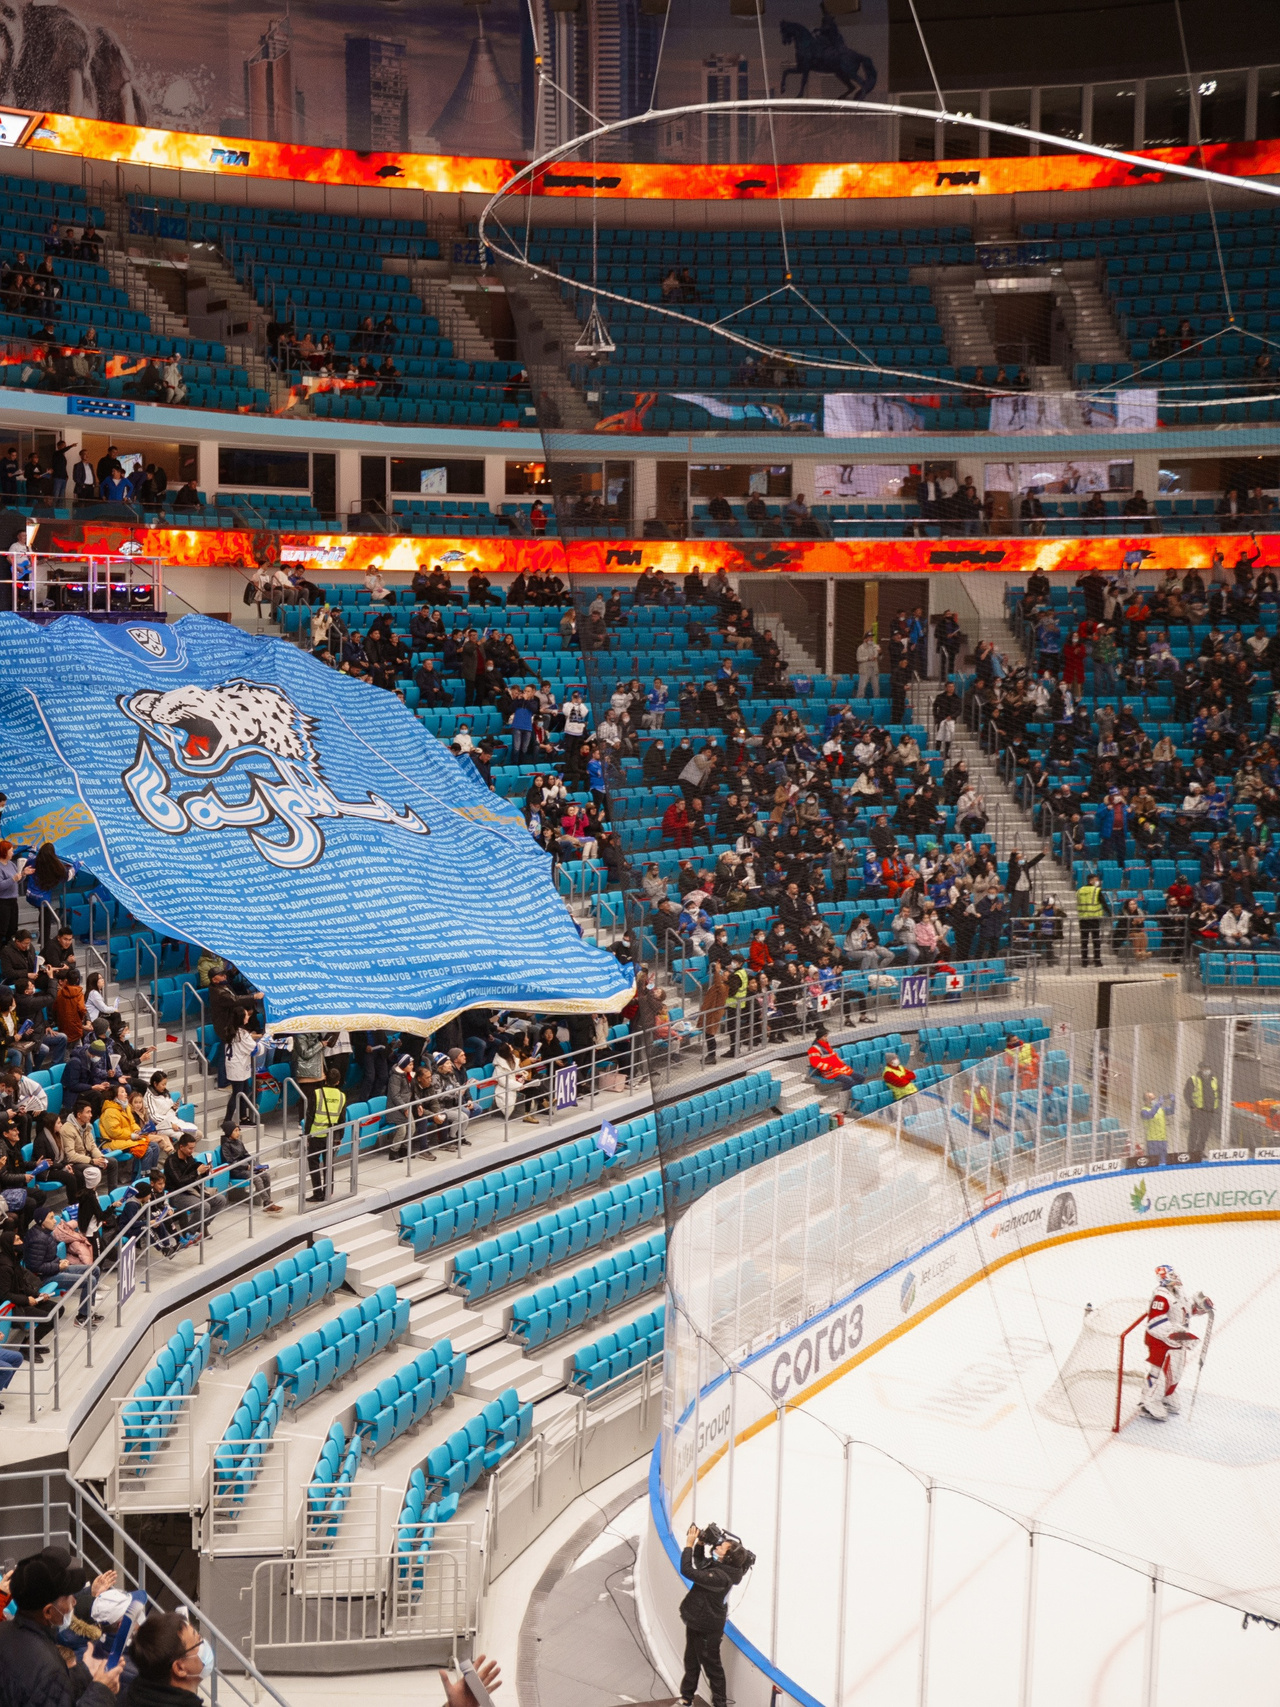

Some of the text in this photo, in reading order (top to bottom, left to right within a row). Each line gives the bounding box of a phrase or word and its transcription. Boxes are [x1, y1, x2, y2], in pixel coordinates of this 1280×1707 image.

[0, 639, 28, 647] КЕВИН
[9, 647, 45, 655] ГРЯЗНОВ
[9, 667, 48, 675] ШУМАХЕР
[56, 664, 86, 674] СЕРГЕЙ
[69, 697, 106, 705] РОМАНОВ
[50, 714, 84, 723] МАКСИМ
[54, 722, 102, 732] ЛИНДЕН ВЕЙ
[89, 730, 120, 739] МАРТЕН
[234, 763, 271, 772] АЛЕКСАНДР
[6, 773, 42, 781] НИКОЛАЙ
[179, 779, 208, 787] РУСТЕМ
[183, 834, 221, 844] ДМИТРИЙ
[349, 833, 375, 842] ОБУХОВ
[109, 844, 137, 854] УППЕР
[180, 842, 224, 854] ШЕВЧЕНКО
[211, 845, 251, 859] АЛЕКСЕЙ
[113, 851, 203, 864] АЛЕКСЕЙ ВЛАСЕНКО
[221, 855, 260, 869] АЛЕКСЕЙ
[119, 860, 214, 875] АЛЕКСЕЙ КУПРИЯНОВ
[299, 856, 387, 874] АНДРЕЙ СПИРИДОНОВ
[125, 869, 184, 884] ПЕТЕРССОН
[192, 864, 269, 879] АНДРЕЙ БОРДЮГ
[339, 866, 402, 879] АРТУР ГАТИЯТОВ
[211, 870, 292, 887] АНДРЕЙ РАЙСКИЙ
[276, 874, 333, 889] ТЮТЮНЬКОВ
[351, 876, 389, 888] БРЭНДОН
[132, 878, 204, 892] ПОЛКОВНИКОВ
[176, 887, 236, 895] ЛИХОТНИКОВ
[246, 892, 288, 904] БРЭНДЕН
[354, 889, 381, 899] ВАДИМ
[147, 894, 241, 908] БАТЫРЛАН МУРАТОВ
[280, 894, 348, 910] ВАДИМ СОЗИНОВ
[353, 897, 389, 910] ВИТАЛИЙ
[496, 893, 533, 908] ВЛАДИМИР
[155, 904, 272, 915] ВАДИМ КРАСНОСЛОБОДЦЕВ
[246, 905, 346, 922] ВИТАЛИЙ СМОЛЬЯНИНОВ
[365, 906, 407, 920] ВЛАДИМИР
[203, 913, 240, 921] ТЕРЕХОВ
[275, 914, 360, 929] ВЛАДИМИР МАТЮХИН
[384, 916, 410, 927] ПАВЕЛ
[417, 920, 465, 932] ШАНГАРЕЕВ
[416, 938, 495, 950] СЕРГЕЙ МЕЛЬНИКОВ
[318, 944, 409, 958] СЕРГЕЙ ЛАВРЕНТЬЕВ
[261, 960, 293, 969] ПУРТОВ
[377, 950, 470, 967] СЕРГЕЙ ЧЕБОТАРЕВСКИЙ
[330, 960, 371, 970] ТРИФОНОВ
[417, 962, 494, 979] ТРЕВОР ЛЕТОВСКИ
[273, 970, 329, 980] АКИМЖАНОВ
[335, 973, 411, 984] ТАЛГАТ ЖАЙЛАУОВ
[495, 968, 545, 981] МОГИЛЬНИКОВ
[269, 983, 319, 993] ТАНГРЭЙДИ
[902, 979, 927, 1006] A14
[438, 984, 518, 1006] АНДРЕЙ ТРОЩИНСКИЙ
[305, 1003, 350, 1011] МУСАТАЕВ
[356, 1001, 432, 1011] АНДРЕЙ СПИРИДОНОВ
[557, 1070, 577, 1106] A13
[1059, 1168, 1084, 1179] KHL.RU
[1092, 1161, 1119, 1172] KHL.RU
[1212, 1150, 1245, 1159] KHL.RU
[1154, 1190, 1277, 1212] GASENERGY
[121, 1245, 136, 1300] A12
[697, 1404, 730, 1453] Group
